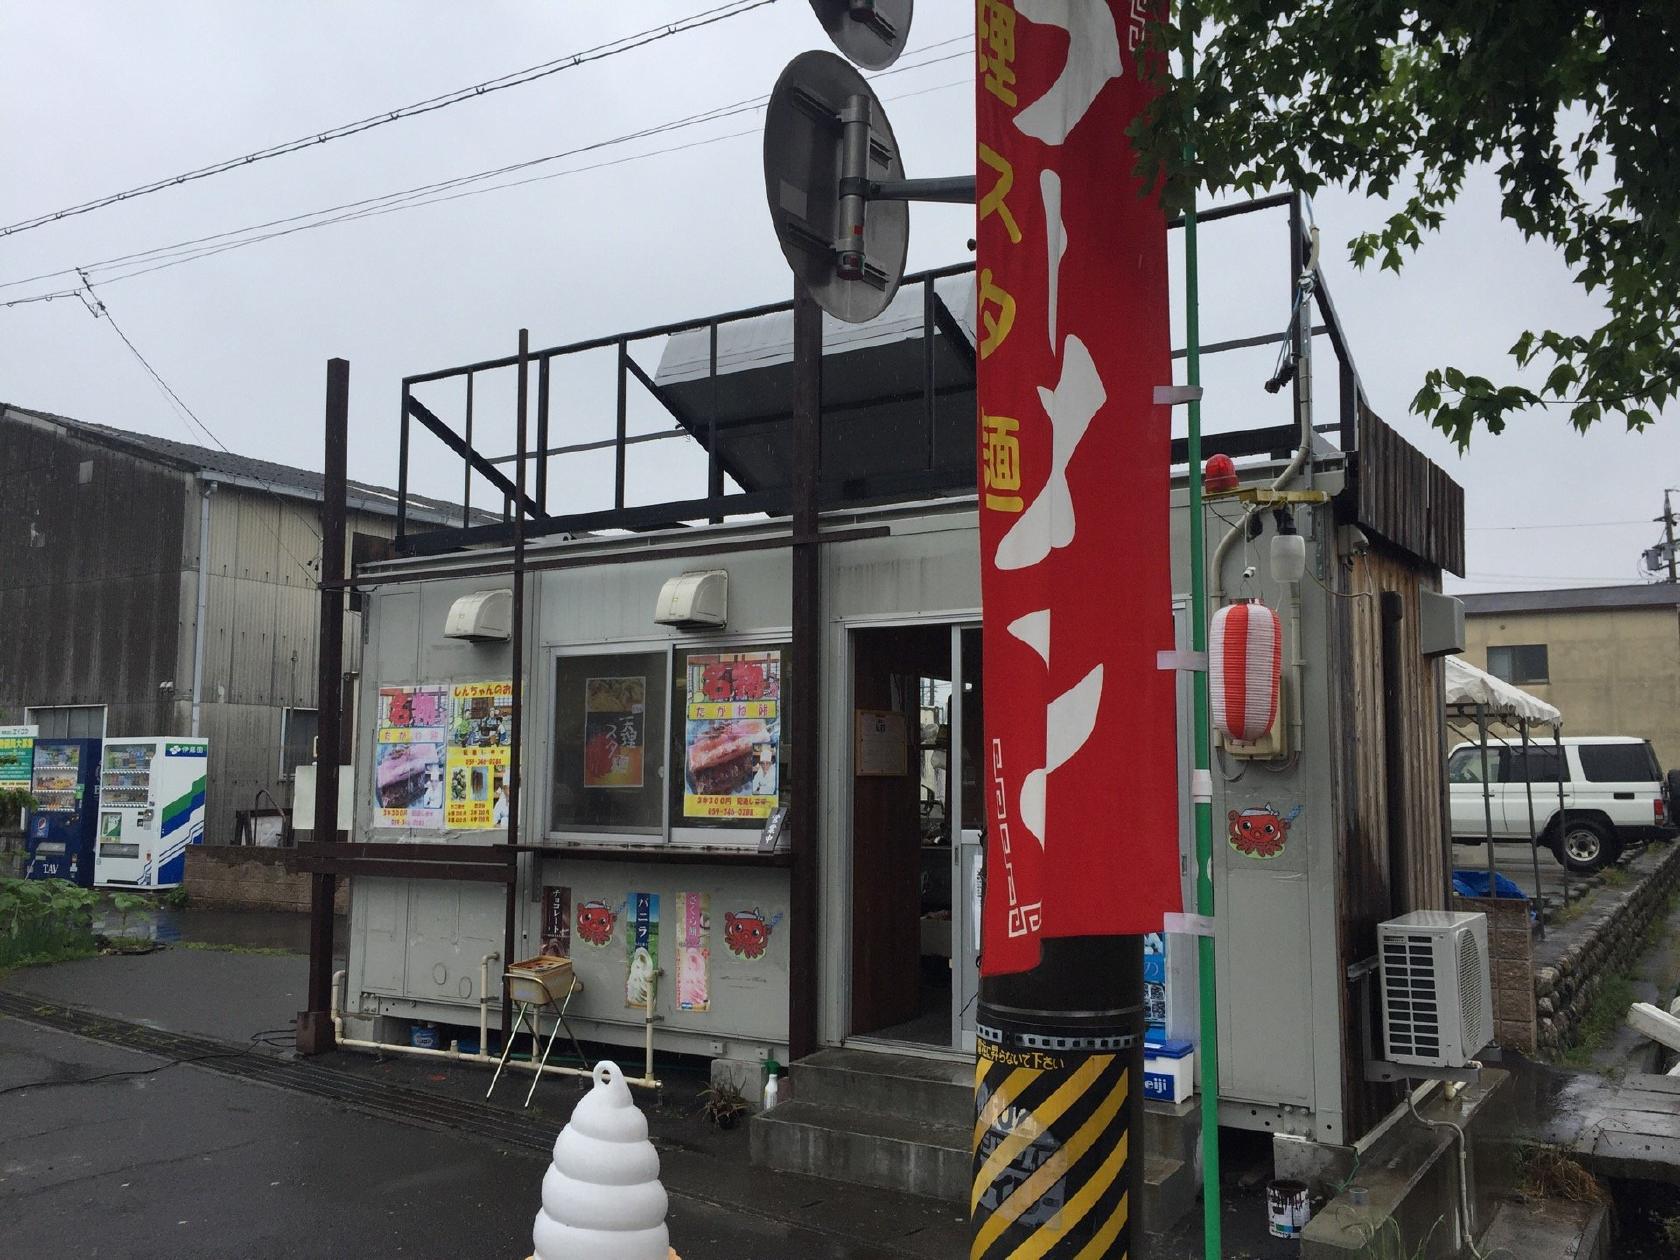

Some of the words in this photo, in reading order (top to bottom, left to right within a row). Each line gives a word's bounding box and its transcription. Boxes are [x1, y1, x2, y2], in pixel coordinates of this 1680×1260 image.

[552, 889, 561, 934] チョコレート
[637, 897, 649, 938] バニラ
[1144, 1077, 1167, 1093] eiji
